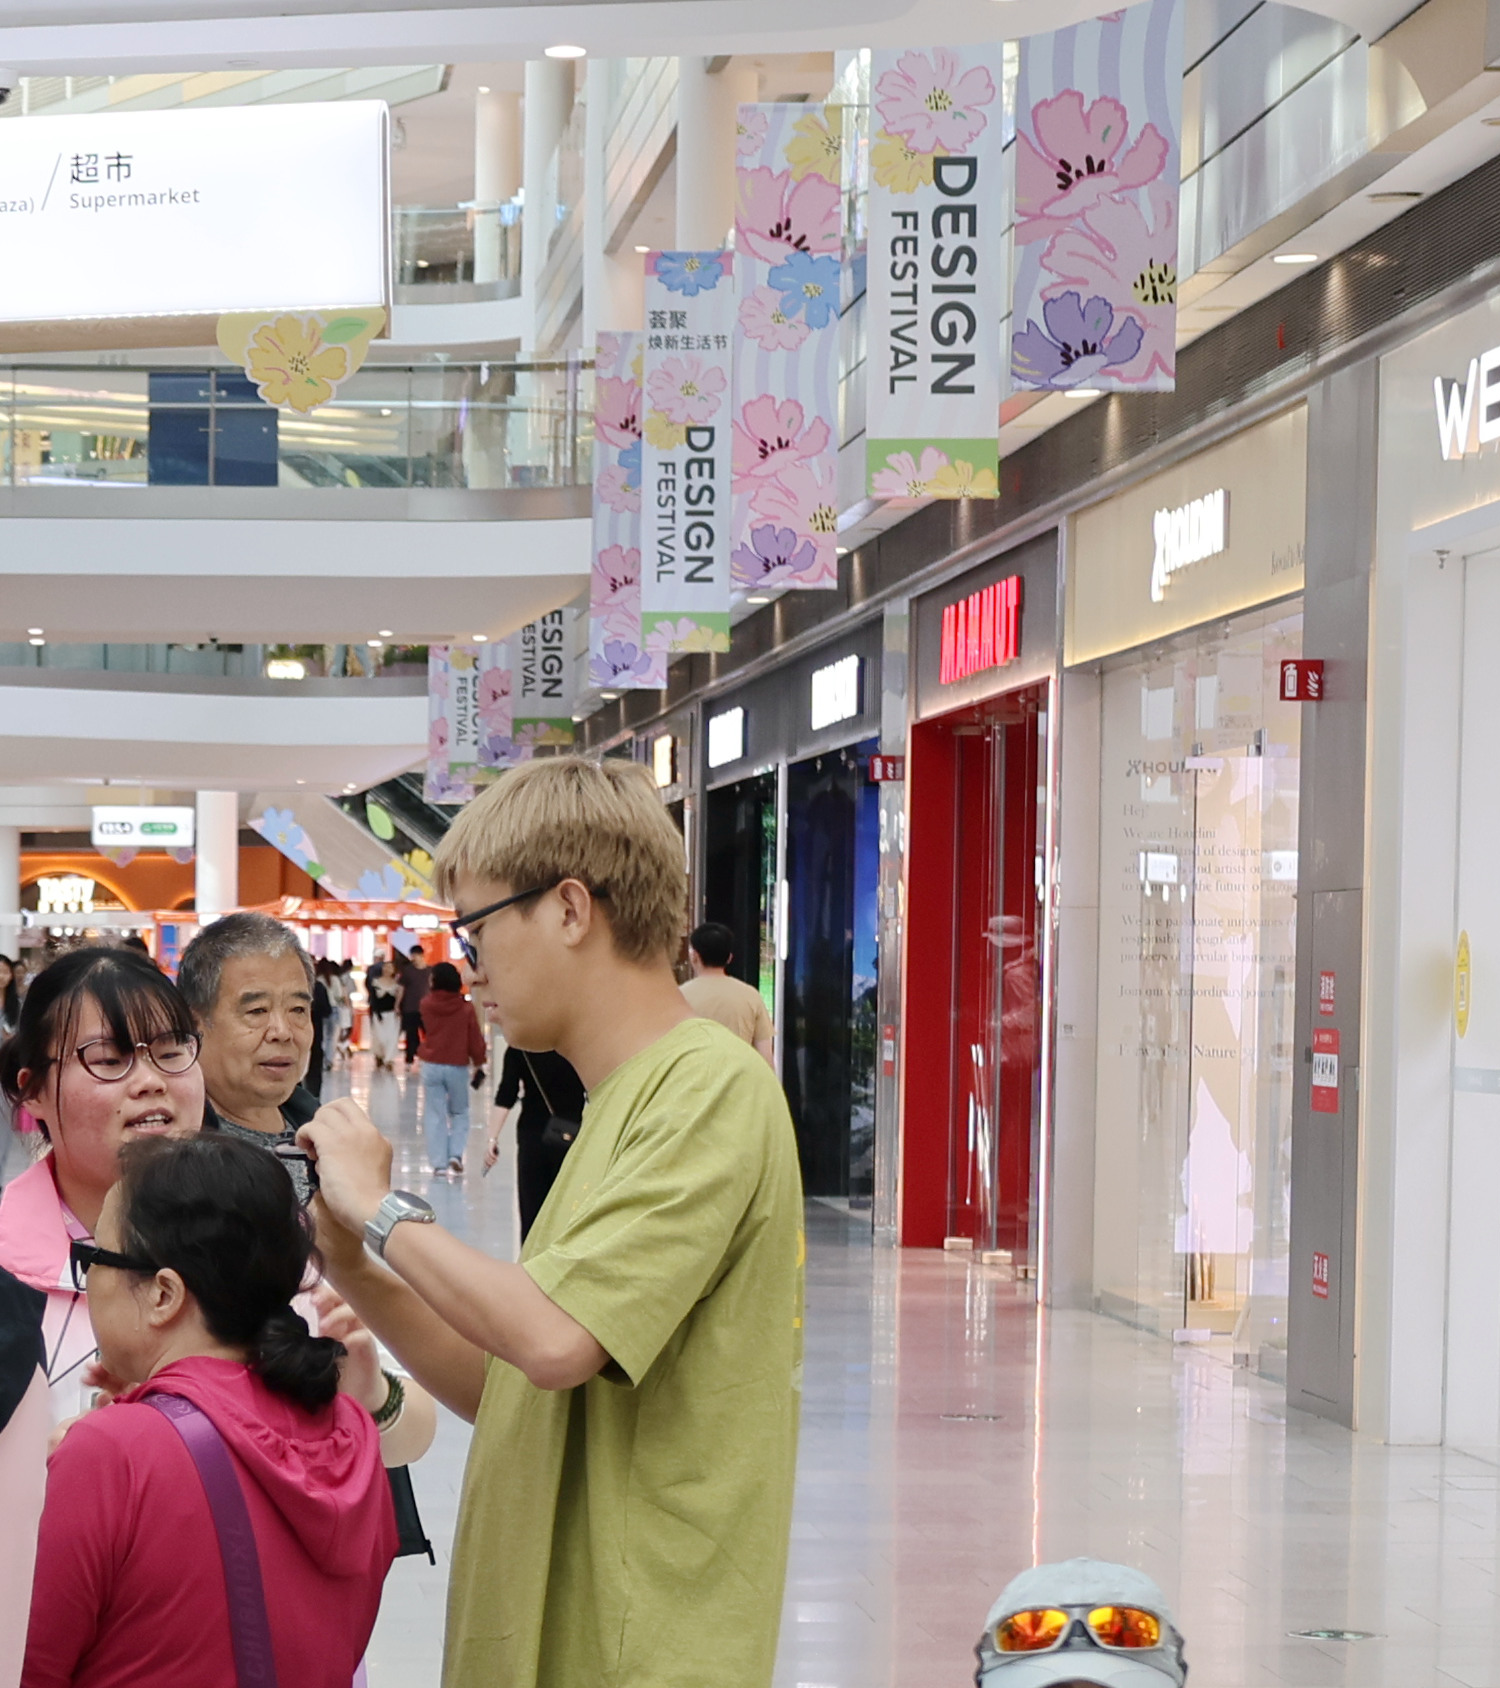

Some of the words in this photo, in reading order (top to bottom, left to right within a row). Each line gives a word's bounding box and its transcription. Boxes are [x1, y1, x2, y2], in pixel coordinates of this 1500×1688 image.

[69, 151, 134, 185] 超市
[69, 187, 201, 213] Supermarket
[889, 209, 919, 394] FESTIVAL
[930, 155, 978, 396] DESIGN
[648, 334, 728, 351] 焕新生活节
[649, 310, 688, 330] 荟聚
[656, 461, 676, 583] FESTIVAL
[684, 426, 715, 583] DESIGN
[522, 623, 536, 698] ESTIVAL
[541, 609, 563, 698] ESIGN
[456, 676, 468, 746] FESTIVAL
